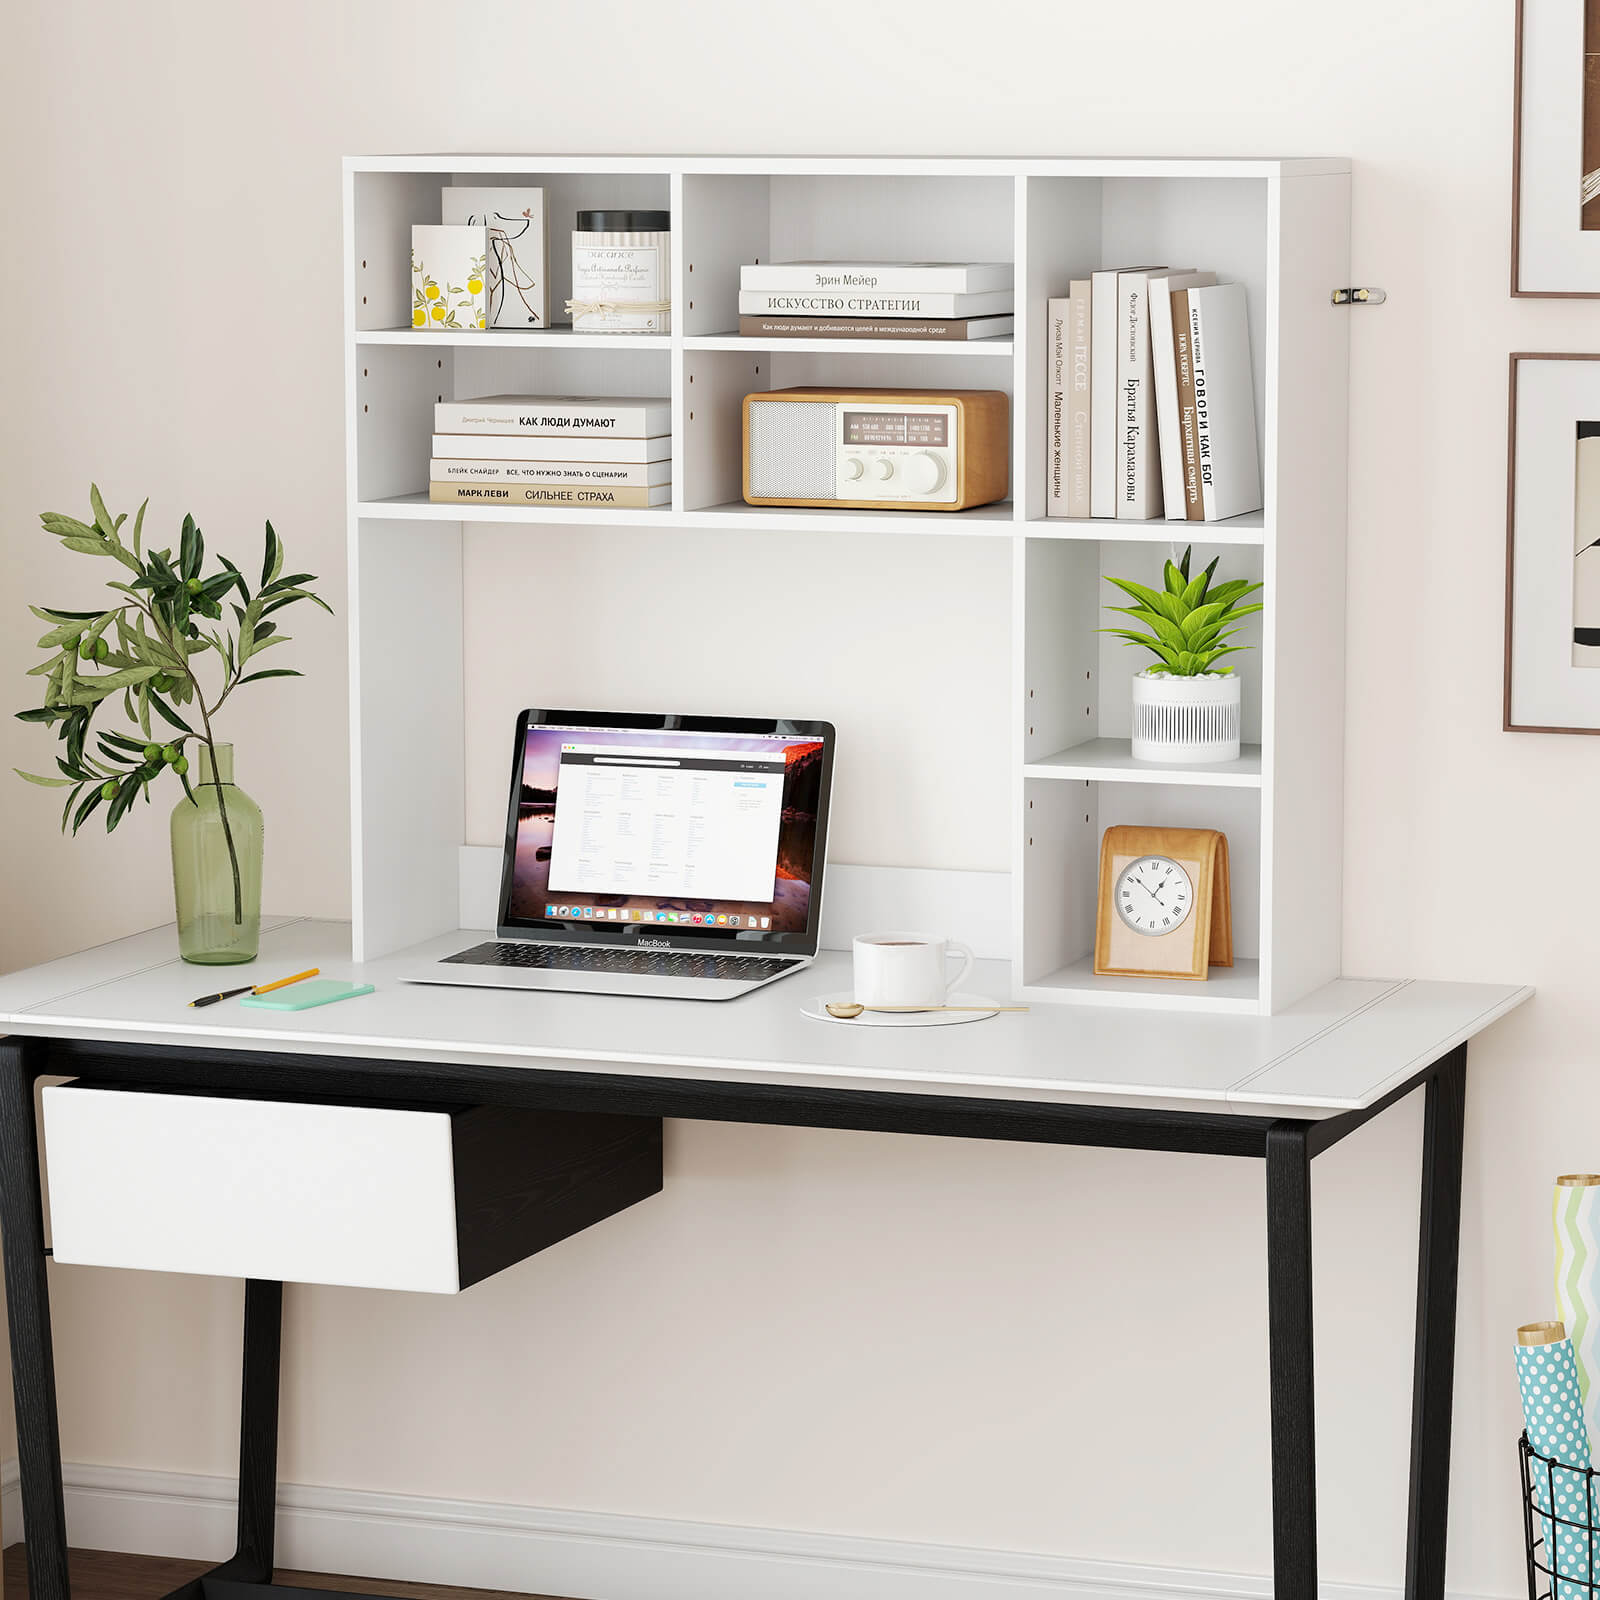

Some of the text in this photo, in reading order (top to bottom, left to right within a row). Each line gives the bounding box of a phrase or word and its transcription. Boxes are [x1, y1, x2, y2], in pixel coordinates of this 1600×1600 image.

[815, 274, 878, 288] Эрин Мейер
[767, 297, 920, 312] ИСКУССТВО СТРАТЕГИИ
[762, 324, 773, 332] Как
[773, 324, 789, 333] люди
[790, 325, 813, 333] думают
[818, 324, 854, 333] добиваются
[854, 326, 873, 334] целей
[879, 326, 928, 335] международной
[928, 327, 946, 335] среде
[1191, 308, 1202, 364] КСЕНИЯ ЧЕРНОВА
[1054, 318, 1064, 386] Луиза Мэй Олкотт
[1074, 345, 1087, 392] ГЕССЕ
[519, 417, 616, 429] КАК ЛЮДИ ДУМАЮТ
[1194, 368, 1213, 487] ГОВОРИ КАК БОГ
[1053, 391, 1063, 499] Маленькие женщины
[1123, 378, 1141, 502] Братья Карамазовы
[1181, 405, 1200, 504] Бархатная смерть
[447, 467, 499, 475] БЛЕЙК СНАЙДЕР
[563, 470, 584, 478] ЗНАТЬ
[592, 471, 628, 479] СЦЕНАРИИ
[457, 489, 509, 498] МАРК ЛЕВИ
[525, 490, 614, 502] СИЛЬНЕЕ СТРАХА
[637, 938, 671, 949] MacBook
